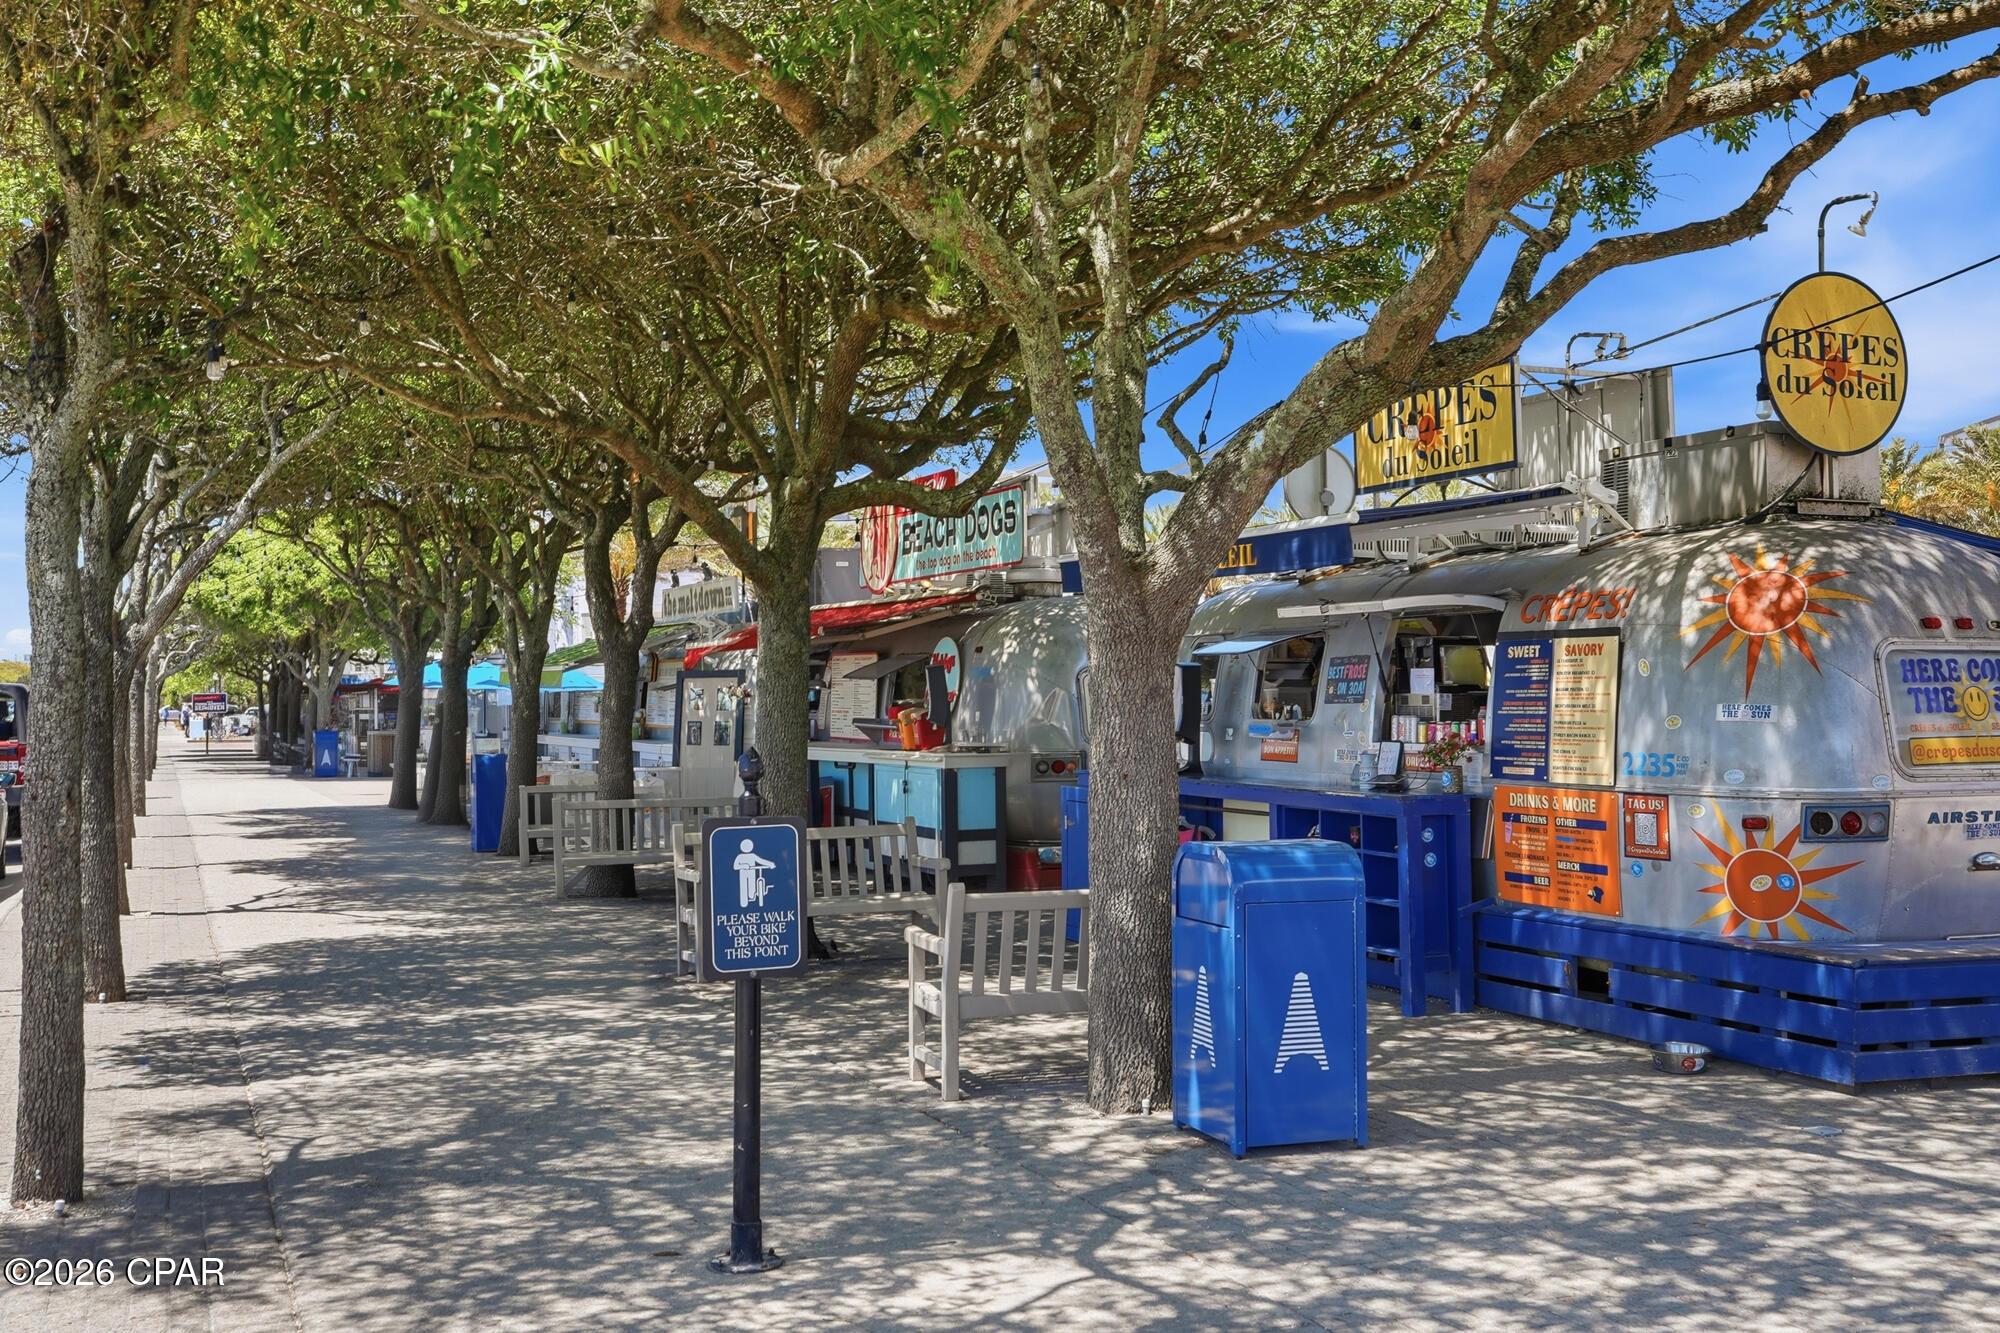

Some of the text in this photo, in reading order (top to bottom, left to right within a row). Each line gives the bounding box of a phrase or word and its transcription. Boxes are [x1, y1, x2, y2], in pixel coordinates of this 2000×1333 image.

[1771, 326, 1899, 368] CRÊPES
[1776, 364, 1898, 402] du Soleil
[1382, 428, 1480, 479] du Soleil
[902, 500, 1016, 556] BEACH DOGS
[963, 551, 974, 562] the
[975, 546, 997, 561] beach
[678, 586, 725, 614] meltdown
[1520, 585, 1636, 624] CRÊPES!
[1507, 645, 1541, 659] SWEET
[1564, 643, 1605, 657] SAVORY
[1328, 666, 1345, 679] BEST
[1900, 658, 2000, 683] HERE CO
[1907, 686, 1958, 714] THE
[1744, 704, 1772, 712] COMES
[1751, 711, 1771, 719] SUN
[1622, 751, 1676, 778] 2235
[1509, 792, 1596, 813] DRINKS & MORE
[1628, 799, 1664, 811] TAG US!
[1520, 814, 1547, 825] FROZENS
[1555, 817, 1577, 828] OTHER
[1557, 860, 1580, 871] MERCH
[1533, 876, 1550, 886] BEER
[717, 910, 795, 926] PLEASE WALK
[726, 922, 787, 936] YOUR BIKE
[734, 934, 779, 948] BEYOND
[725, 945, 788, 960] THIS POINT
